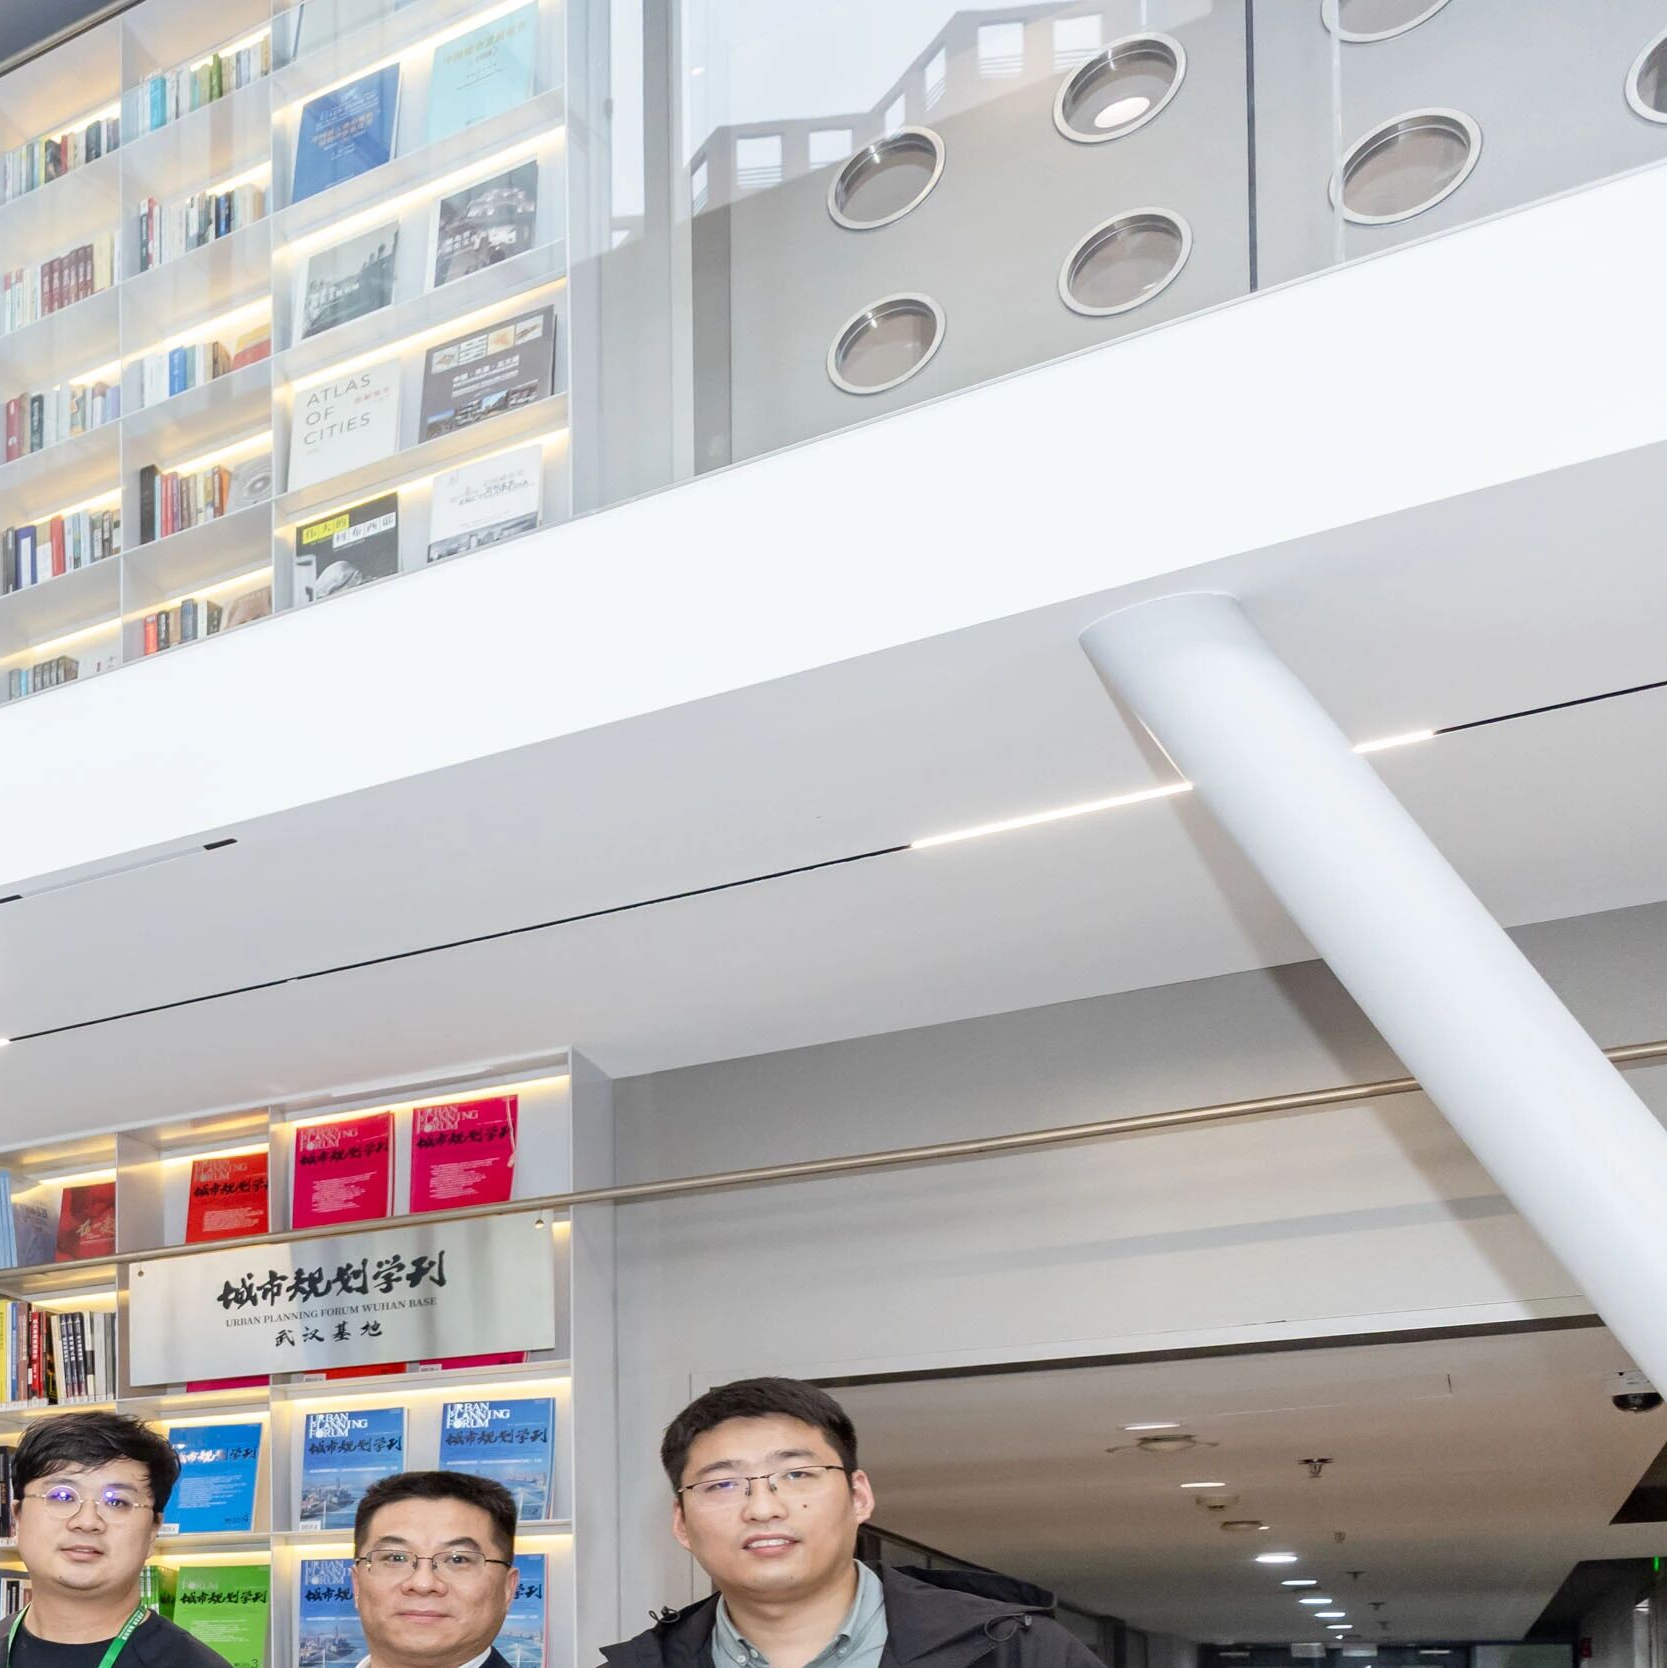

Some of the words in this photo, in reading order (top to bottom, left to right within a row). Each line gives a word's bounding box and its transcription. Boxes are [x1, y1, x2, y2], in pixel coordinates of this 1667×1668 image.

[307, 374, 372, 407] ATLAS
[307, 407, 336, 427] OF
[304, 412, 371, 446] CITIES
[217, 1250, 447, 1311] 城市规划学刊
[226, 1316, 261, 1328] URBAN
[264, 1310, 318, 1324] PLANNING
[320, 1304, 360, 1319] FORUM
[361, 1299, 407, 1314] WUHAN
[408, 1296, 437, 1309] BASE
[275, 1319, 383, 1348] 武汉基地
[446, 1402, 490, 1415] URBAN
[446, 1408, 511, 1422] PLANNING
[310, 1411, 350, 1424] URBAN
[446, 1417, 490, 1430] FORUM
[310, 1418, 369, 1432] PLANNING
[309, 1426, 350, 1440] FORUM
[250, 1658, 259, 1668] 3
